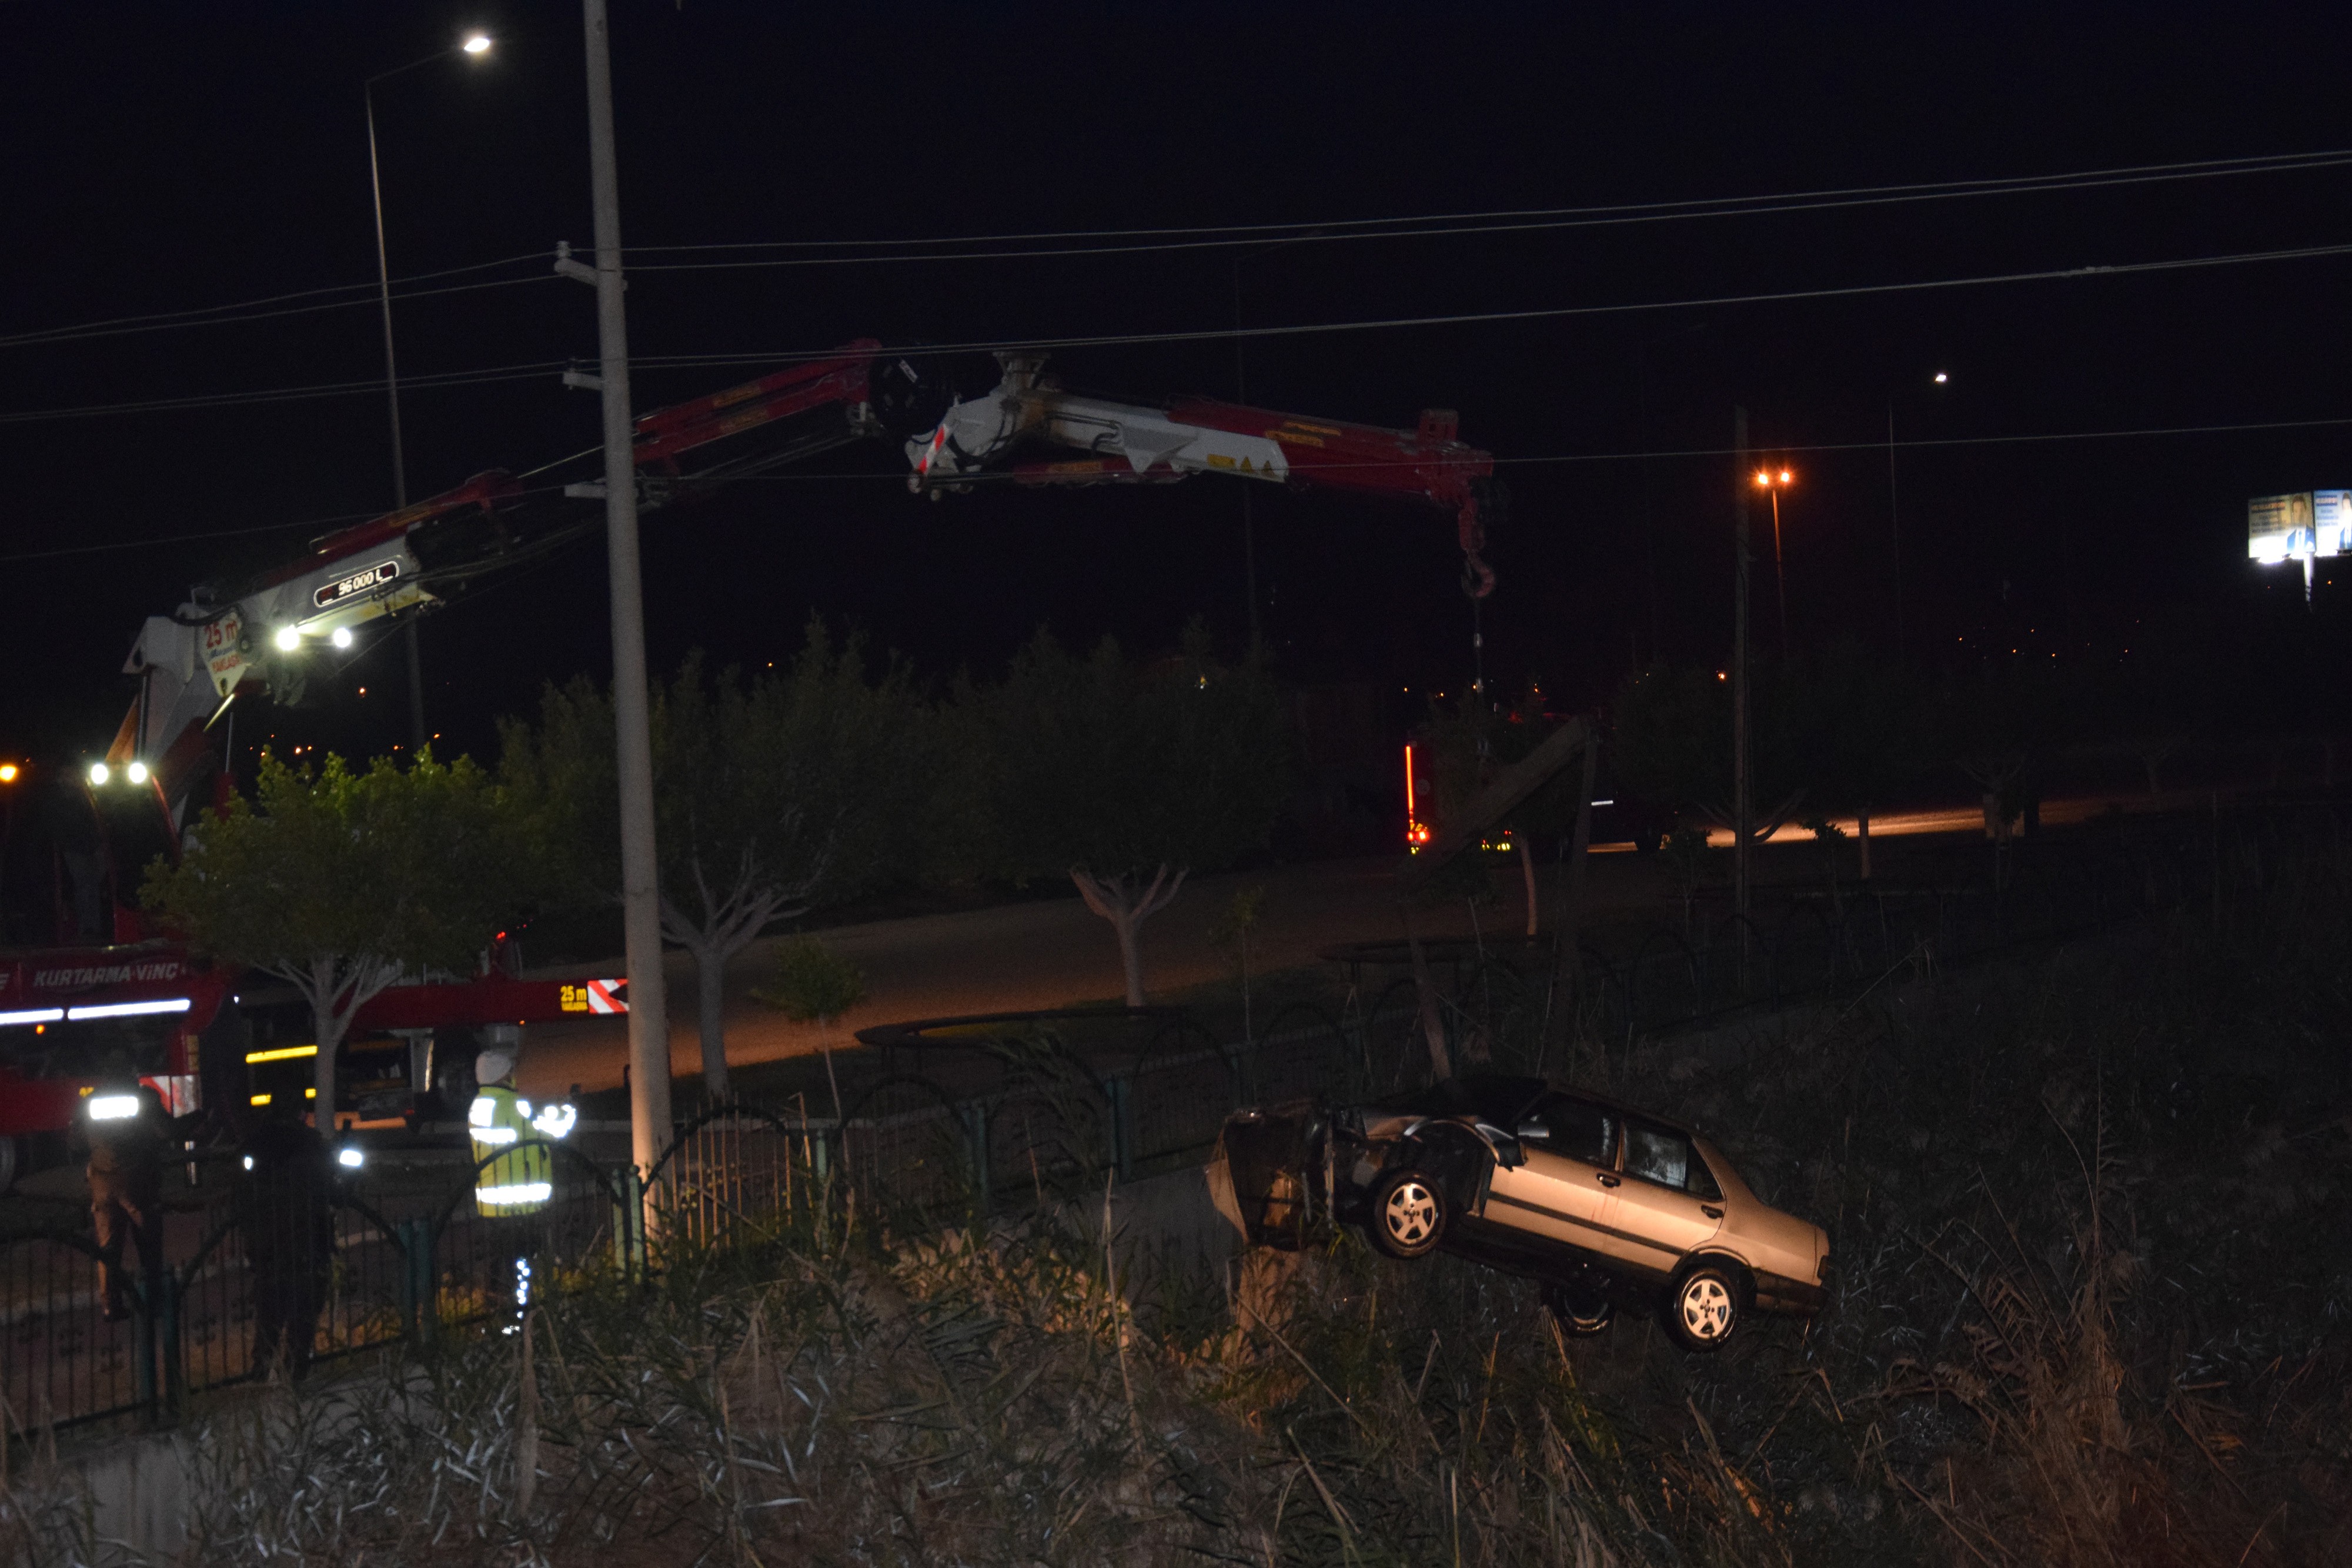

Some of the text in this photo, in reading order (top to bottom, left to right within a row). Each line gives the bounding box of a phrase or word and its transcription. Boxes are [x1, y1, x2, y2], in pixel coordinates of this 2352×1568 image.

[203, 621, 222, 649] 25
[33, 965, 131, 987] KURTARMA
[560, 985, 587, 1001] 25 m
